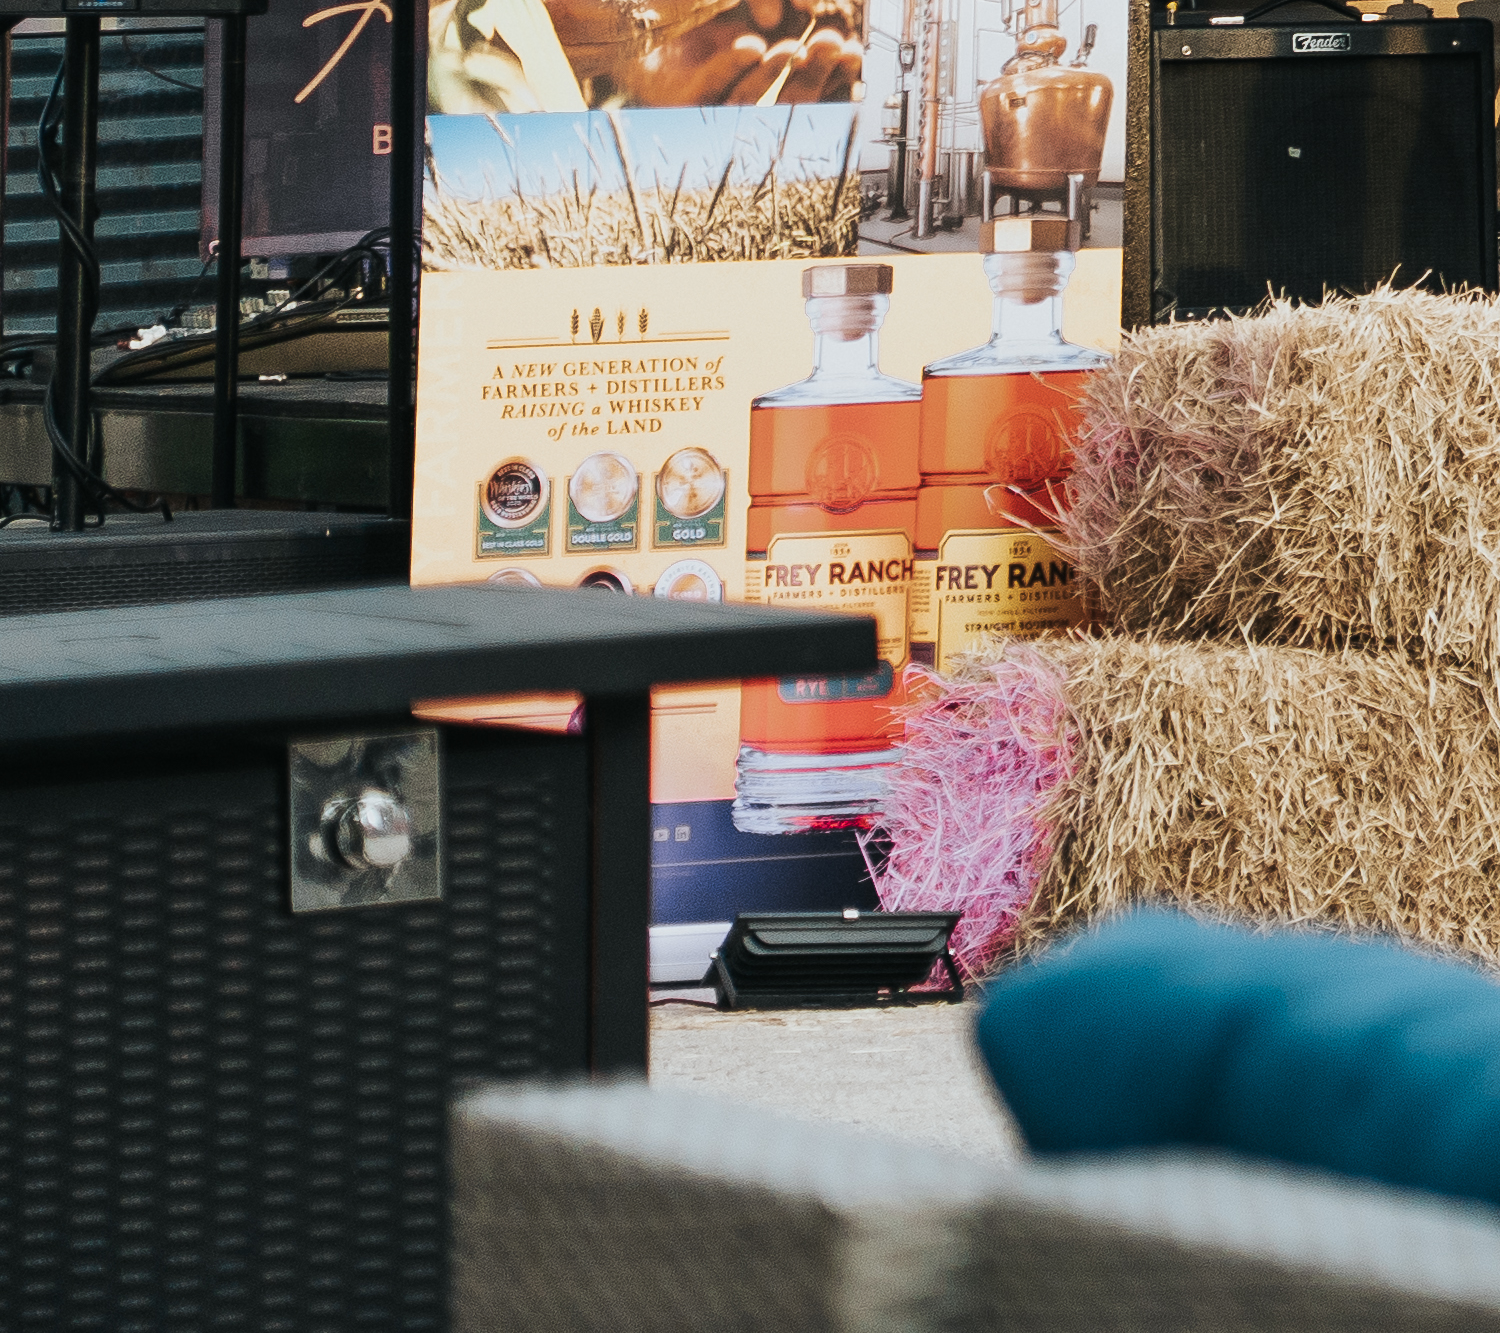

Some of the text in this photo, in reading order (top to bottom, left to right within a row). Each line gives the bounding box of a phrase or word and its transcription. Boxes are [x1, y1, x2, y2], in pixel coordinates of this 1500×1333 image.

[1298, 34, 1347, 50] Fender
[491, 355, 725, 380] A NEW GENERATION of
[481, 381, 580, 400] FARMERS
[606, 376, 725, 395] DISTILLERS
[500, 396, 705, 419] RAISING a WHISKEY
[547, 418, 663, 442] of the LAND
[571, 532, 633, 545] DOUBLE GOLD
[672, 527, 707, 541] GOLD
[765, 563, 822, 587] FREY
[829, 559, 915, 585] RANCH
[936, 565, 1000, 590] FREY
[773, 590, 823, 599] FARMERS
[839, 585, 905, 597] DISTILLERS
[945, 593, 1000, 604] FARMERS
[963, 621, 1017, 633] STRAIGHT
[795, 680, 828, 696] RYE
